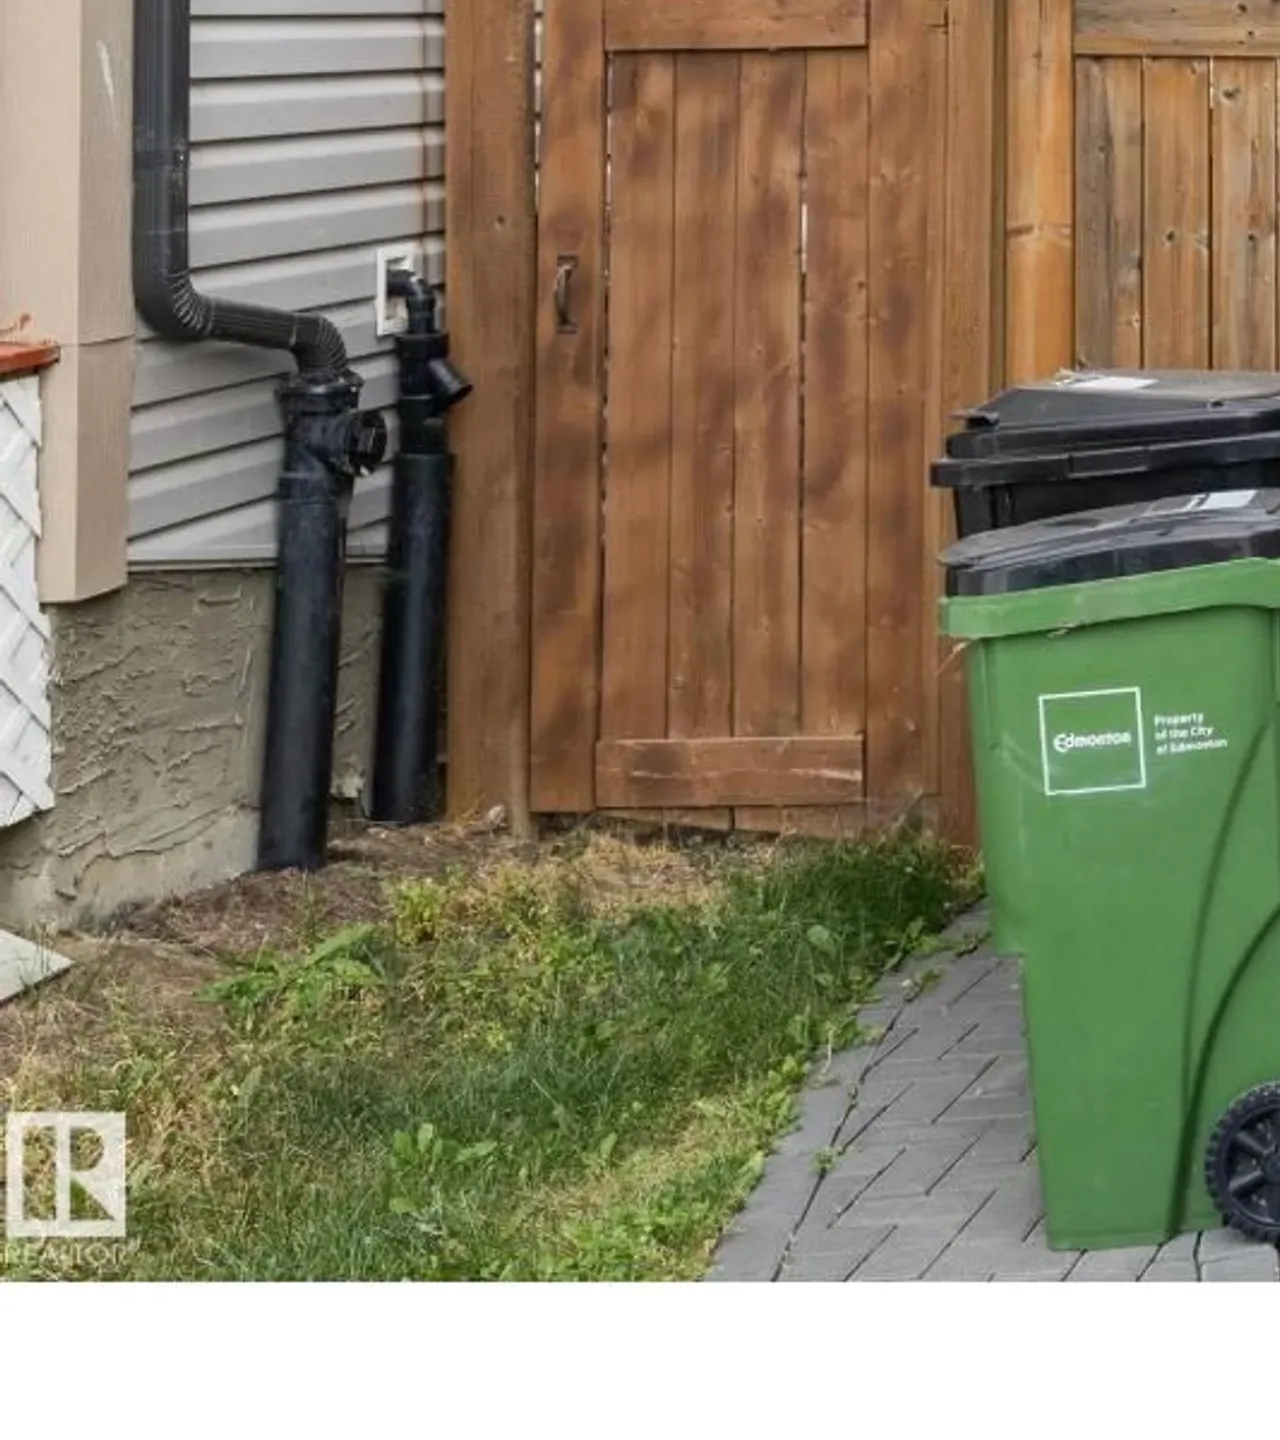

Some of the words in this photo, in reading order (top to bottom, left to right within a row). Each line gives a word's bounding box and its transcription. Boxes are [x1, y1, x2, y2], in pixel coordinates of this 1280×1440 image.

[1154, 713, 1204, 727] Property
[1190, 725, 1214, 737] City
[1053, 732, 1132, 753] Edmonton
[1170, 739, 1228, 753] Edmonton
